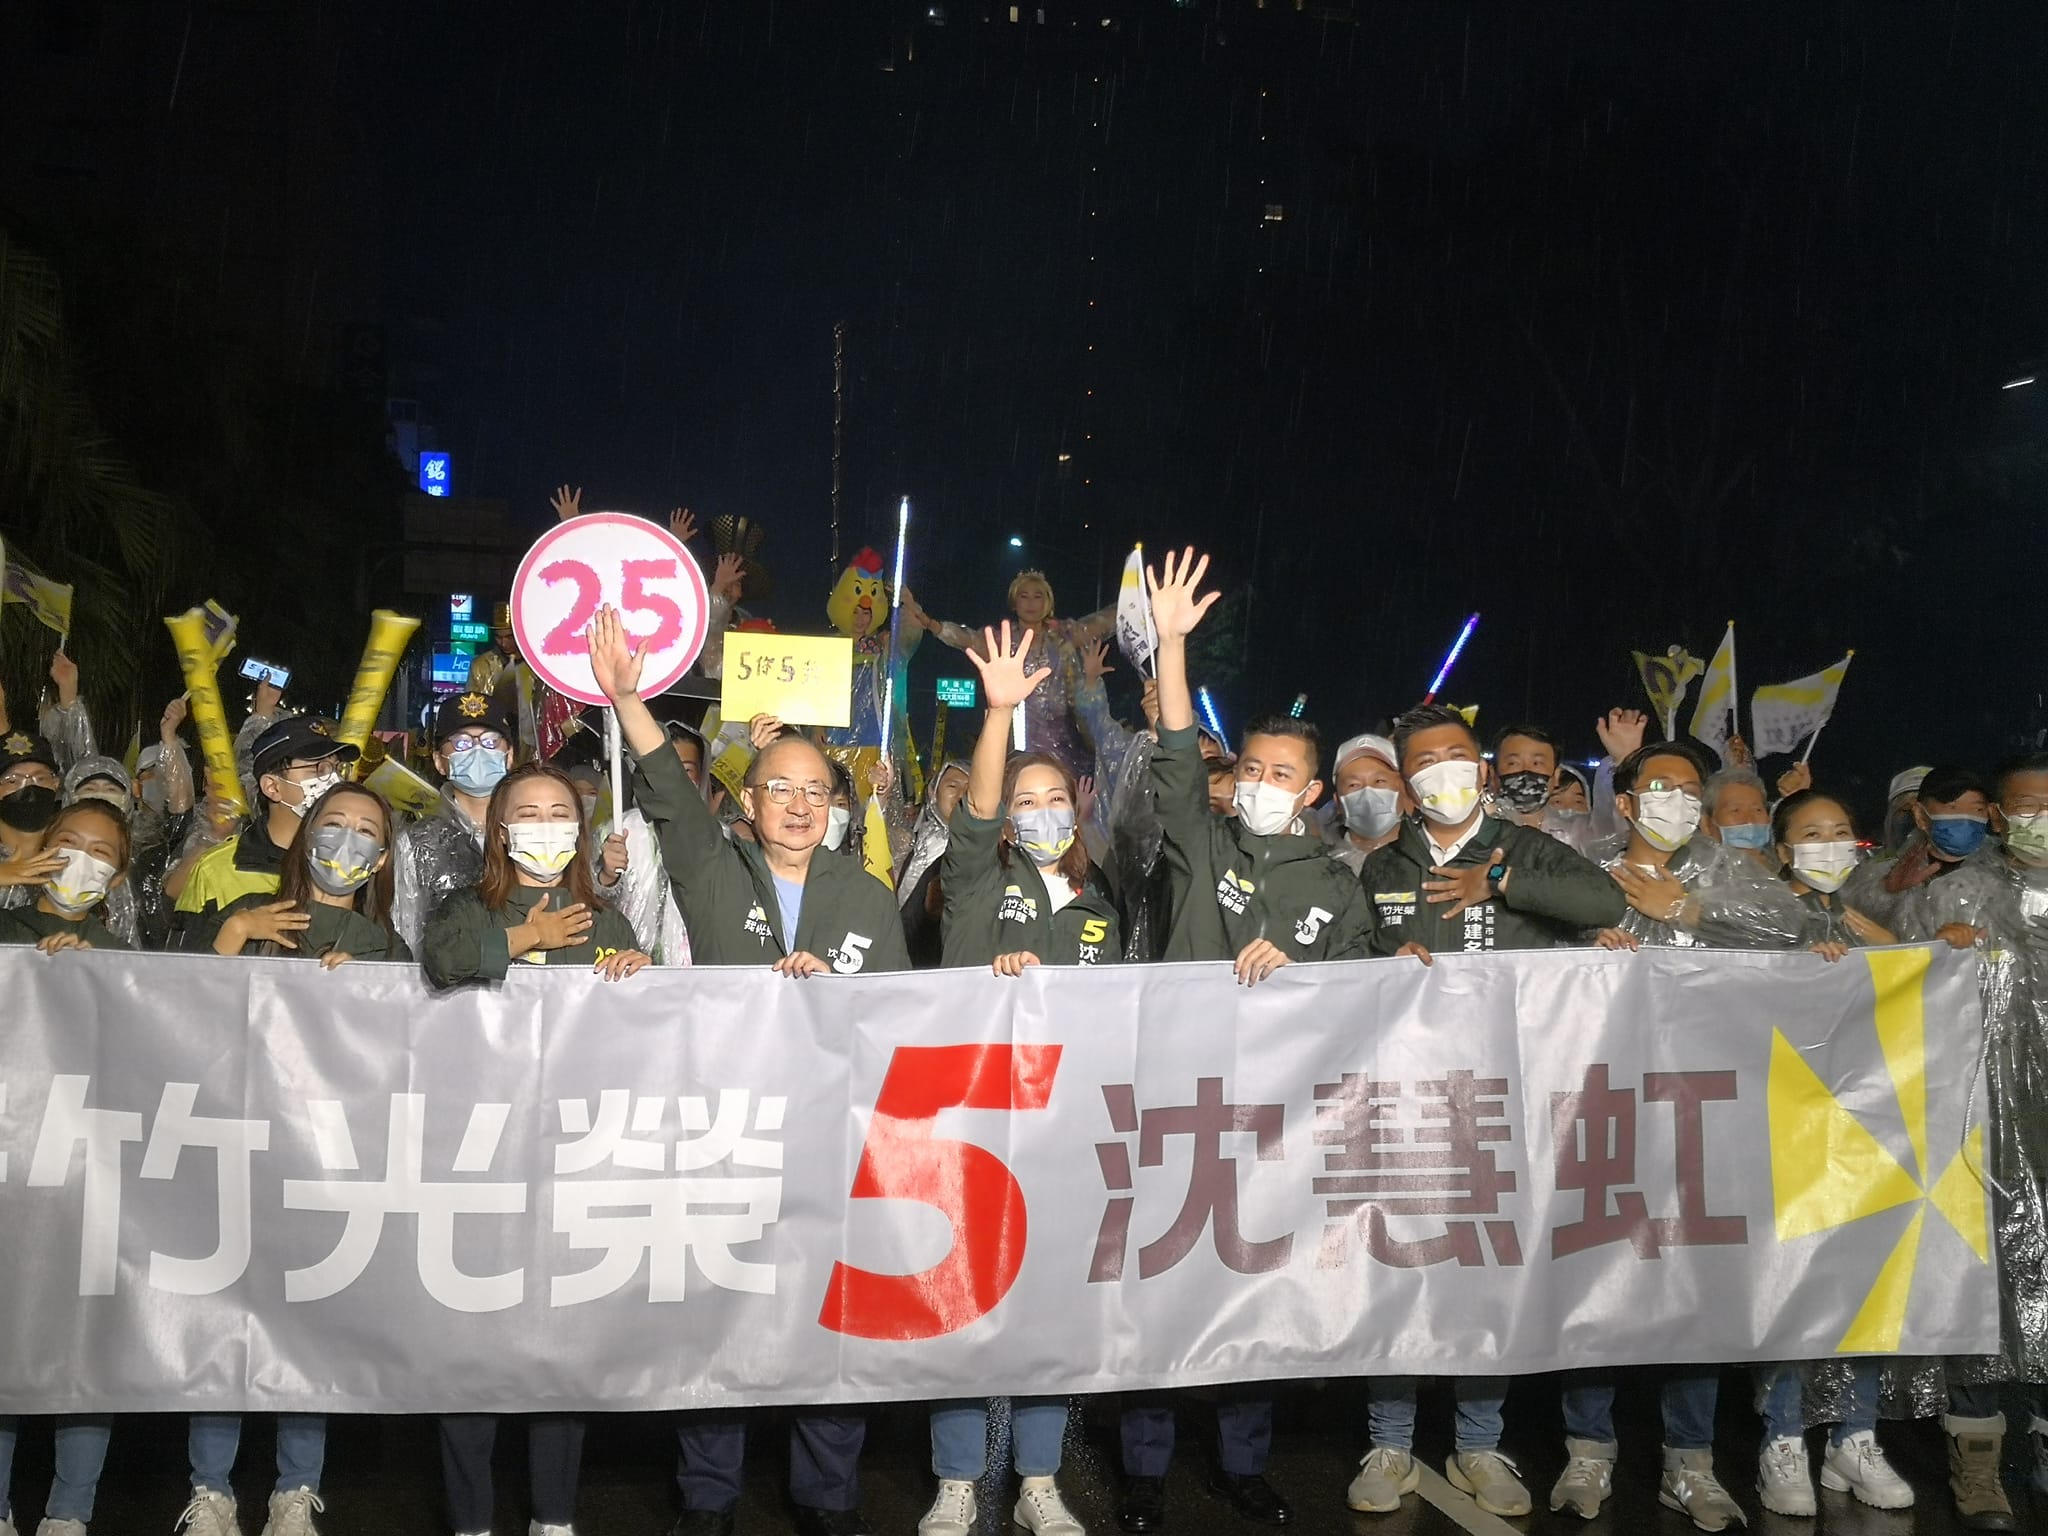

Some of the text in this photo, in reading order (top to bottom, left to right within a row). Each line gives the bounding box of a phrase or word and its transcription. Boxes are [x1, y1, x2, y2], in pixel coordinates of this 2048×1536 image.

[537, 559, 683, 656] 25
[1080, 919, 1108, 943] 5
[1294, 906, 1334, 945] 5
[1379, 905, 1416, 916] 竹光榮
[832, 931, 873, 974] 5
[0, 1043, 1749, 1341] 竹光榮 5 沈慧虹
